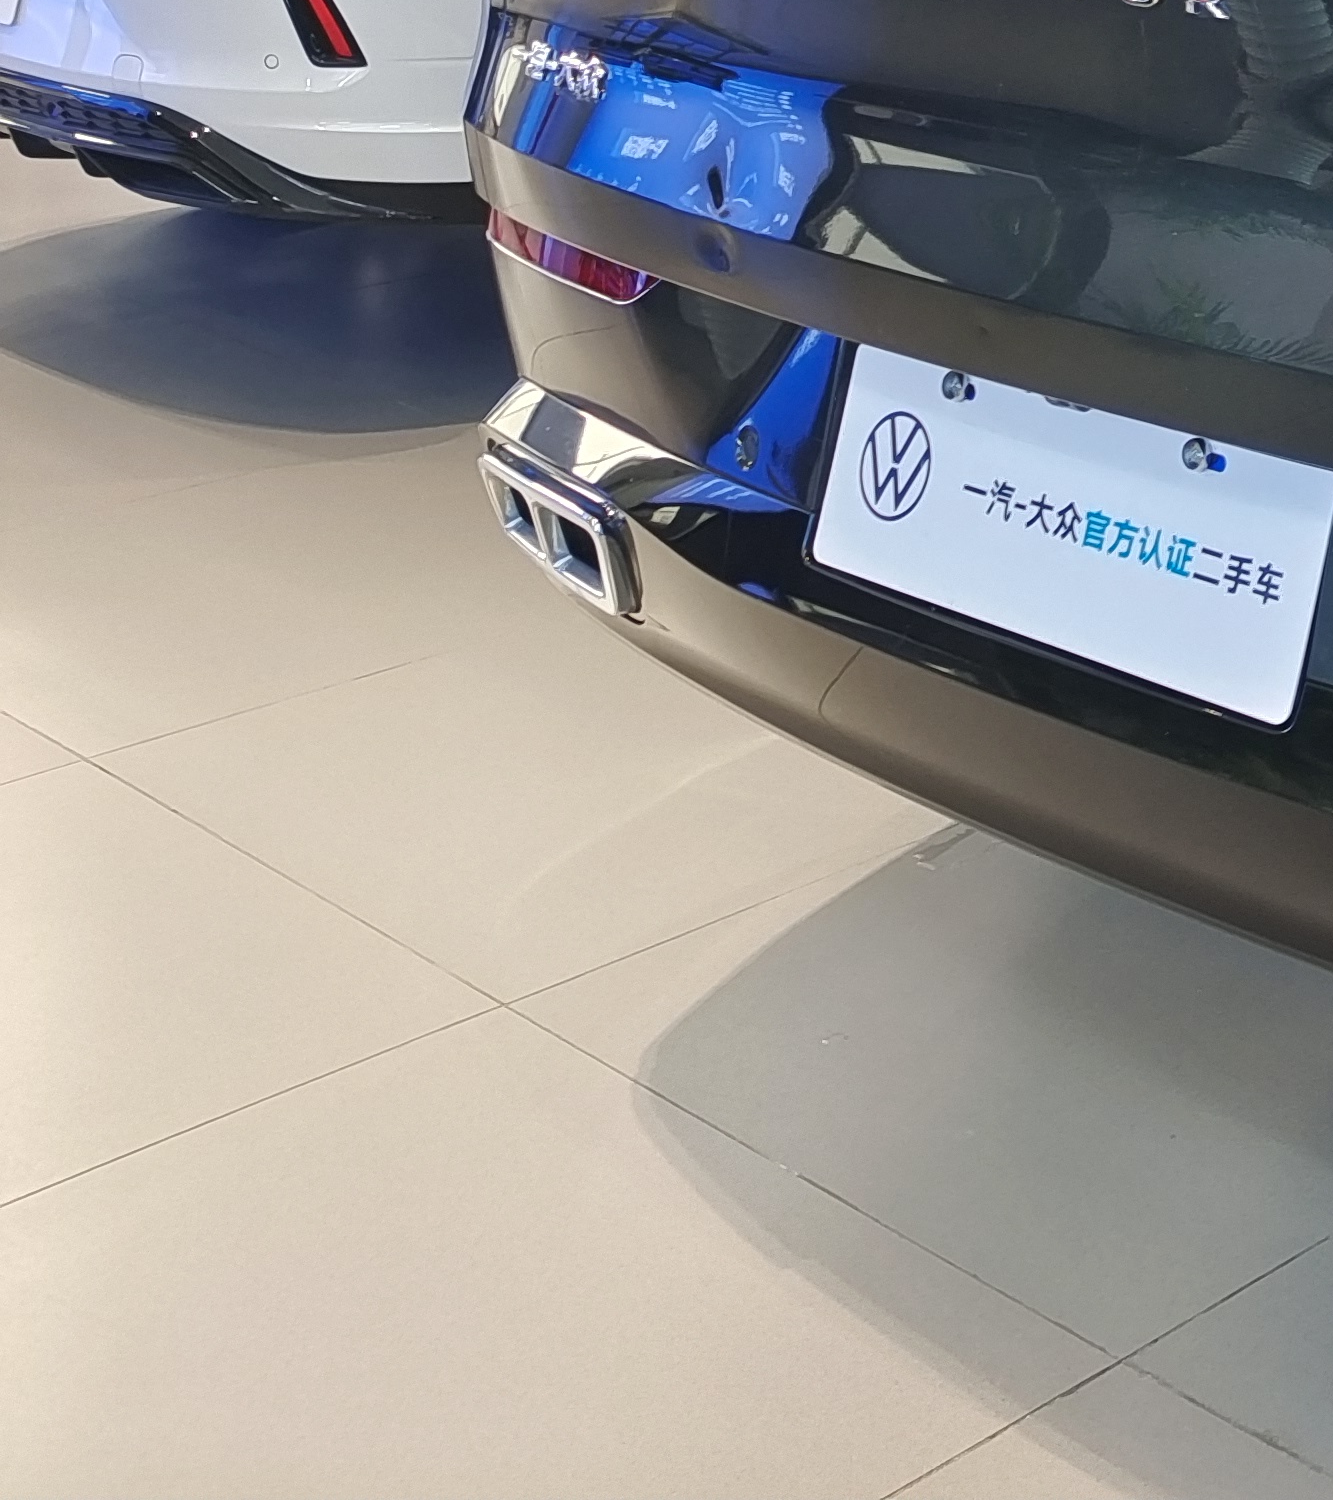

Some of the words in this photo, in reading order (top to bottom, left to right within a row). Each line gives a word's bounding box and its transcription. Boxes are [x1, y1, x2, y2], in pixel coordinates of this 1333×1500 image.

[962, 479, 1285, 605] 一汽-大众官方认证二手车
